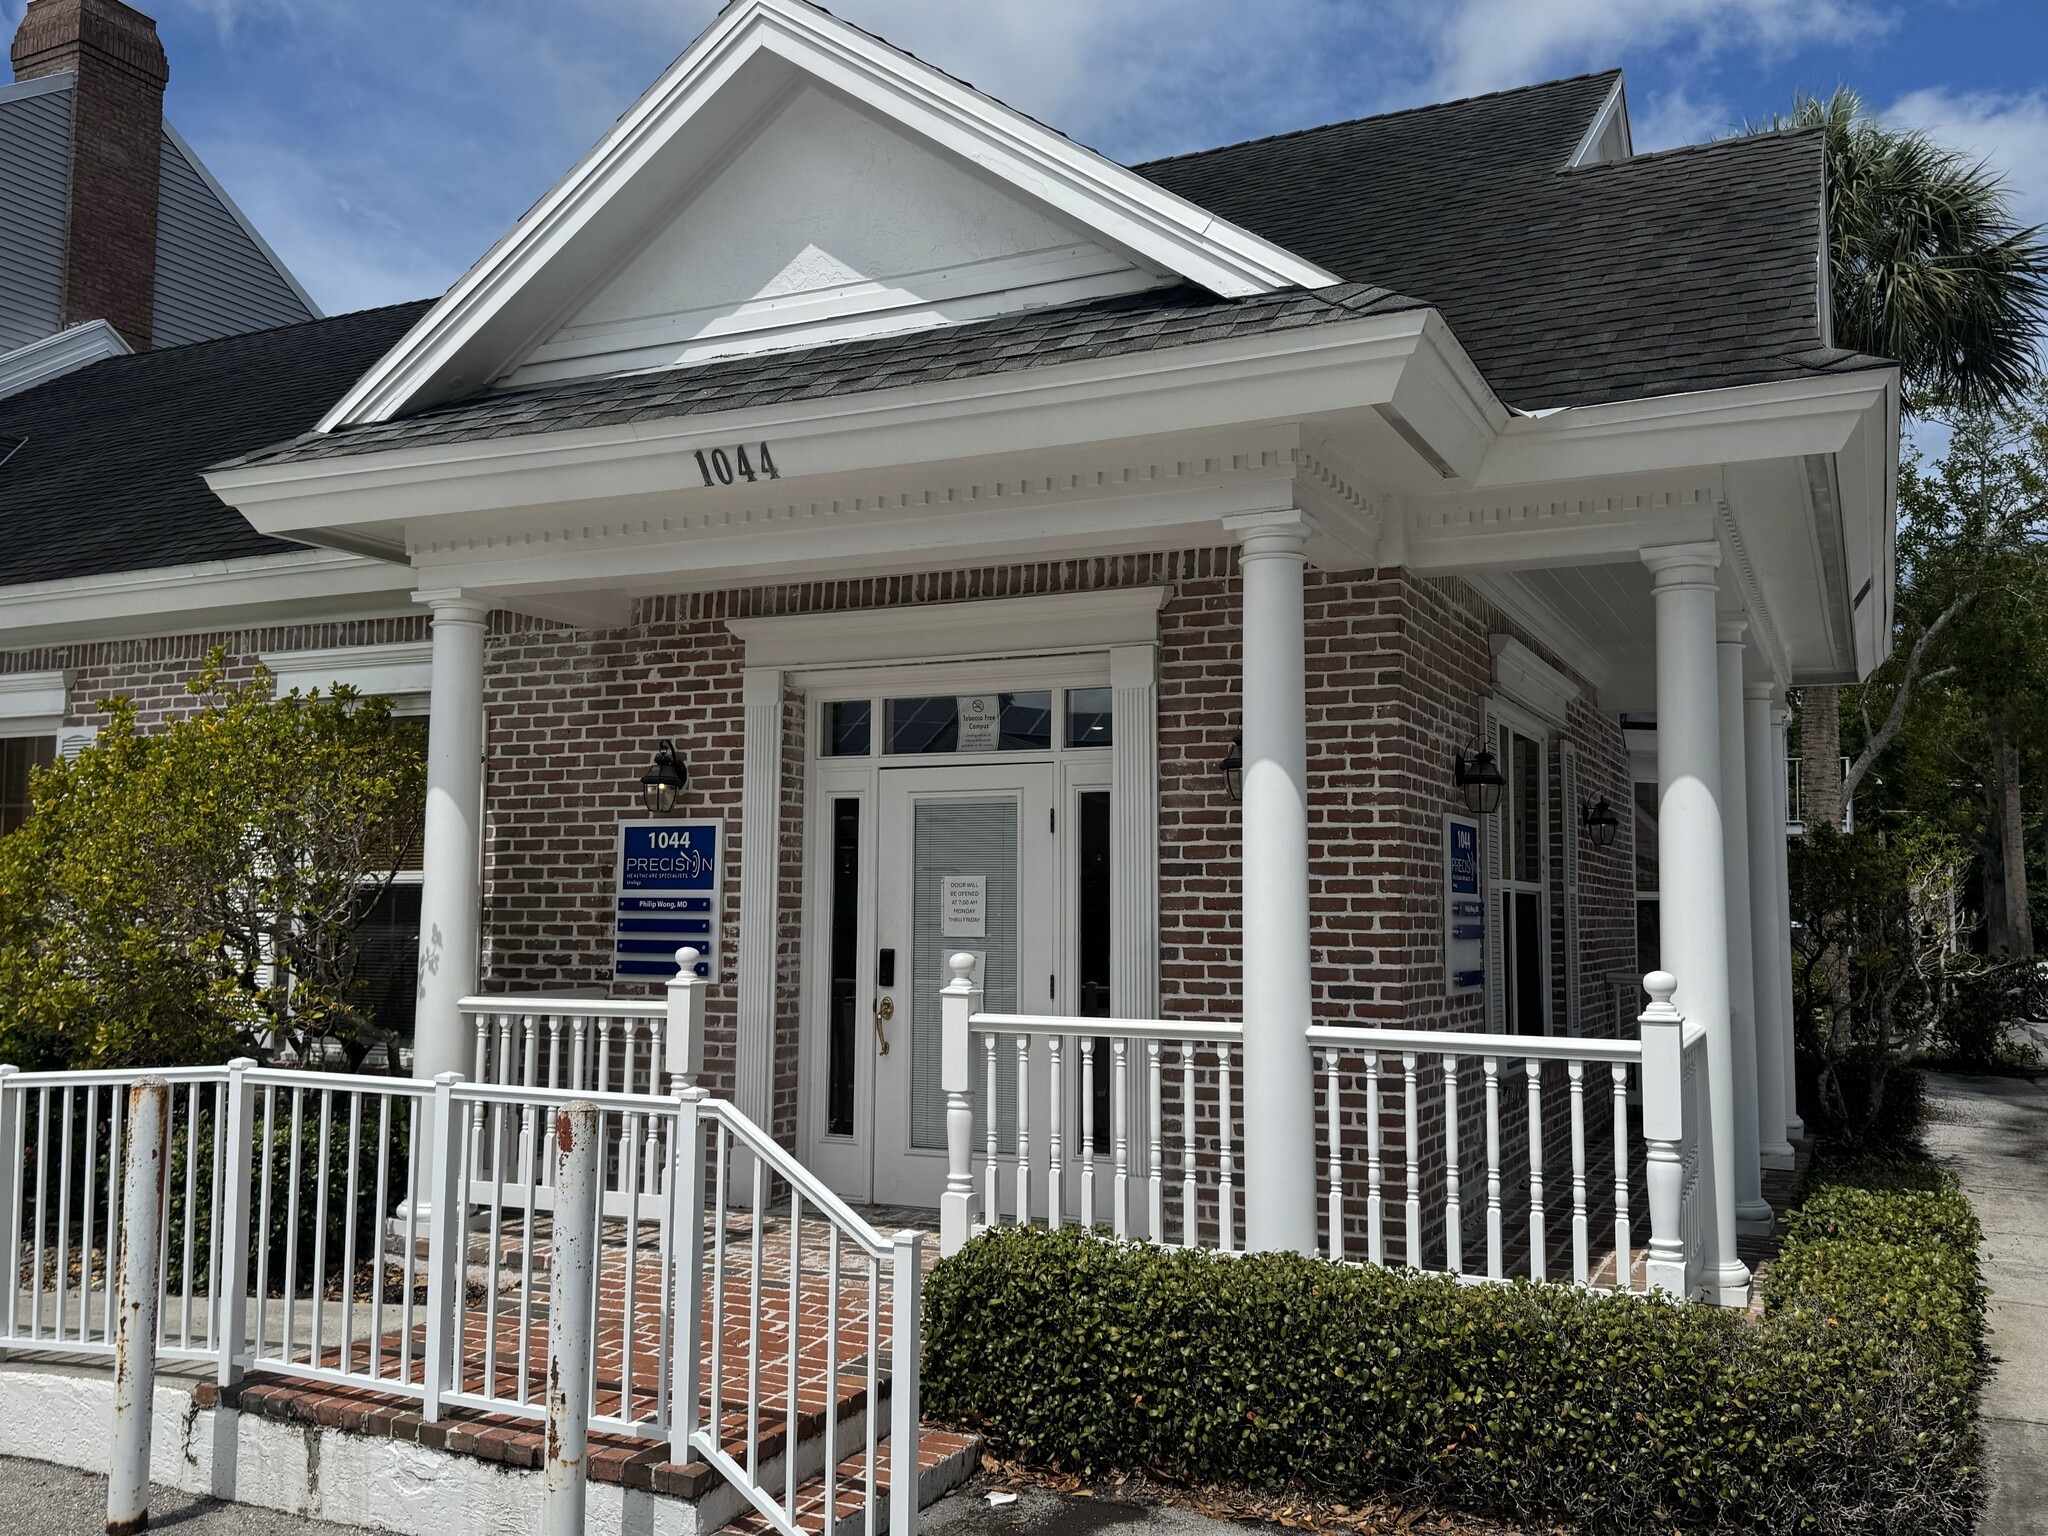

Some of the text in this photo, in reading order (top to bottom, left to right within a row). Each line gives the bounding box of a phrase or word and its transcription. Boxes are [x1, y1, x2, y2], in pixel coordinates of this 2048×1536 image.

[693, 441, 781, 488] 1044
[962, 713, 996, 722] Tobacco Free
[968, 722, 990, 731] Campus
[648, 831, 691, 849] 1044
[1457, 830, 1471, 849] 1044
[639, 901, 657, 909] Philip
[657, 901, 676, 910] Wong,
